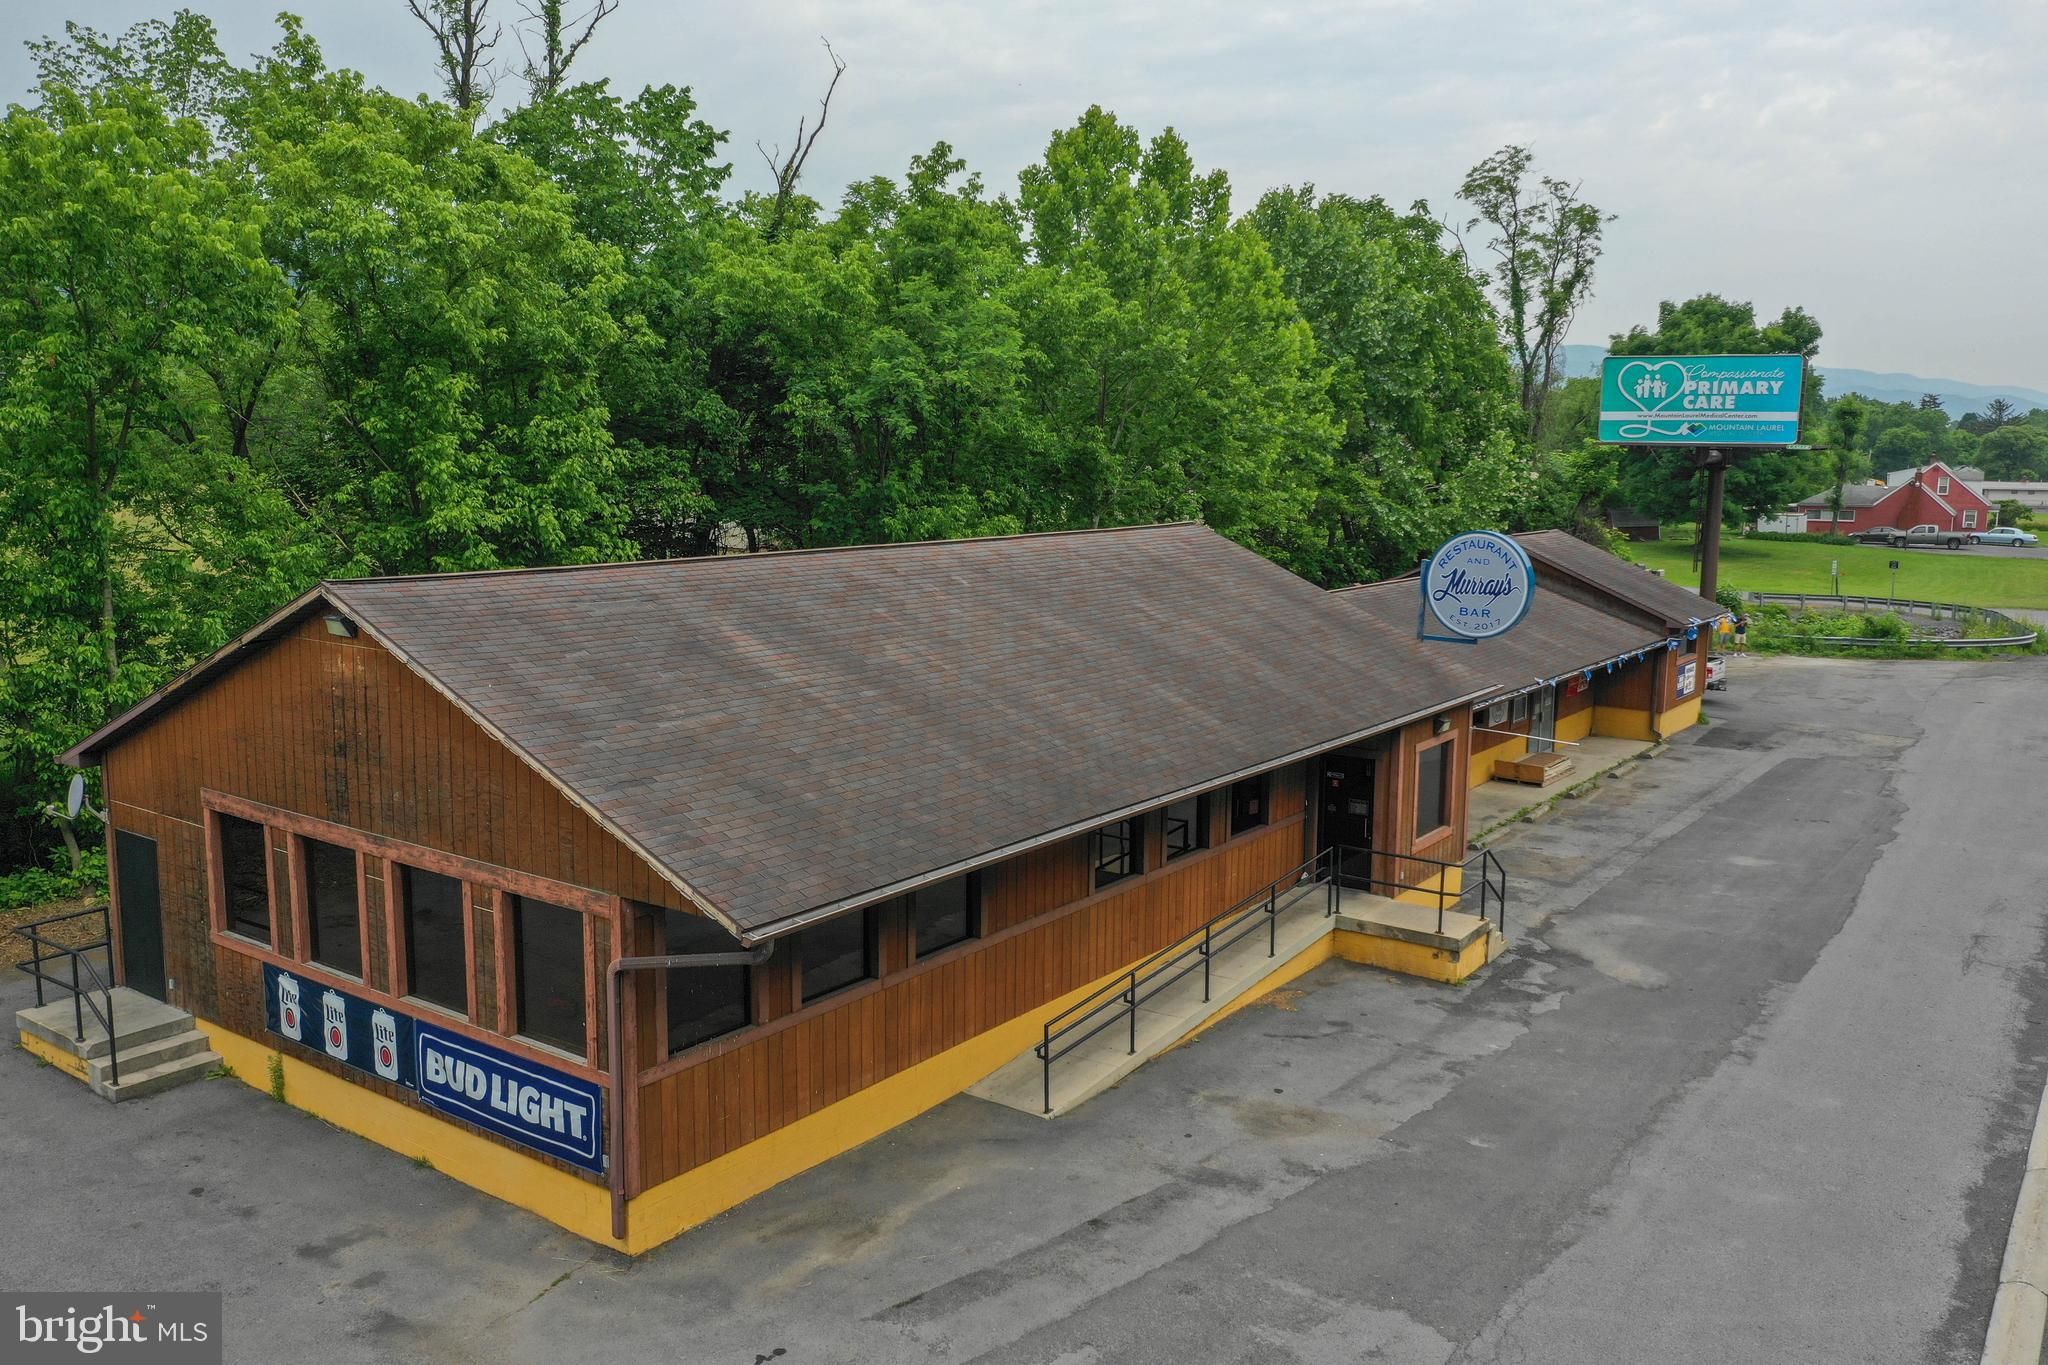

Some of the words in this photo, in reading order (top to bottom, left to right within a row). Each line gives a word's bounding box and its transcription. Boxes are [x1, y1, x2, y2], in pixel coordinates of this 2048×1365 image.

[1684, 364, 1785, 382] Compassionate
[1683, 380, 1784, 395] PRIMARY
[1682, 395, 1736, 410] CARE
[1708, 423, 1755, 431] MOUNTAIN
[1756, 424, 1785, 432] LAUREL
[1438, 540, 1518, 571] RESTAURANT
[1466, 558, 1490, 566] AND
[1432, 567, 1521, 607] Murray's
[1459, 607, 1491, 618] BAR
[1474, 618, 1501, 631] 2017
[280, 987, 298, 1006] Lite
[325, 1004, 344, 1024] Lite
[374, 1023, 395, 1043] Lite
[425, 1047, 488, 1101] BUD
[490, 1072, 588, 1141] LIGHT
